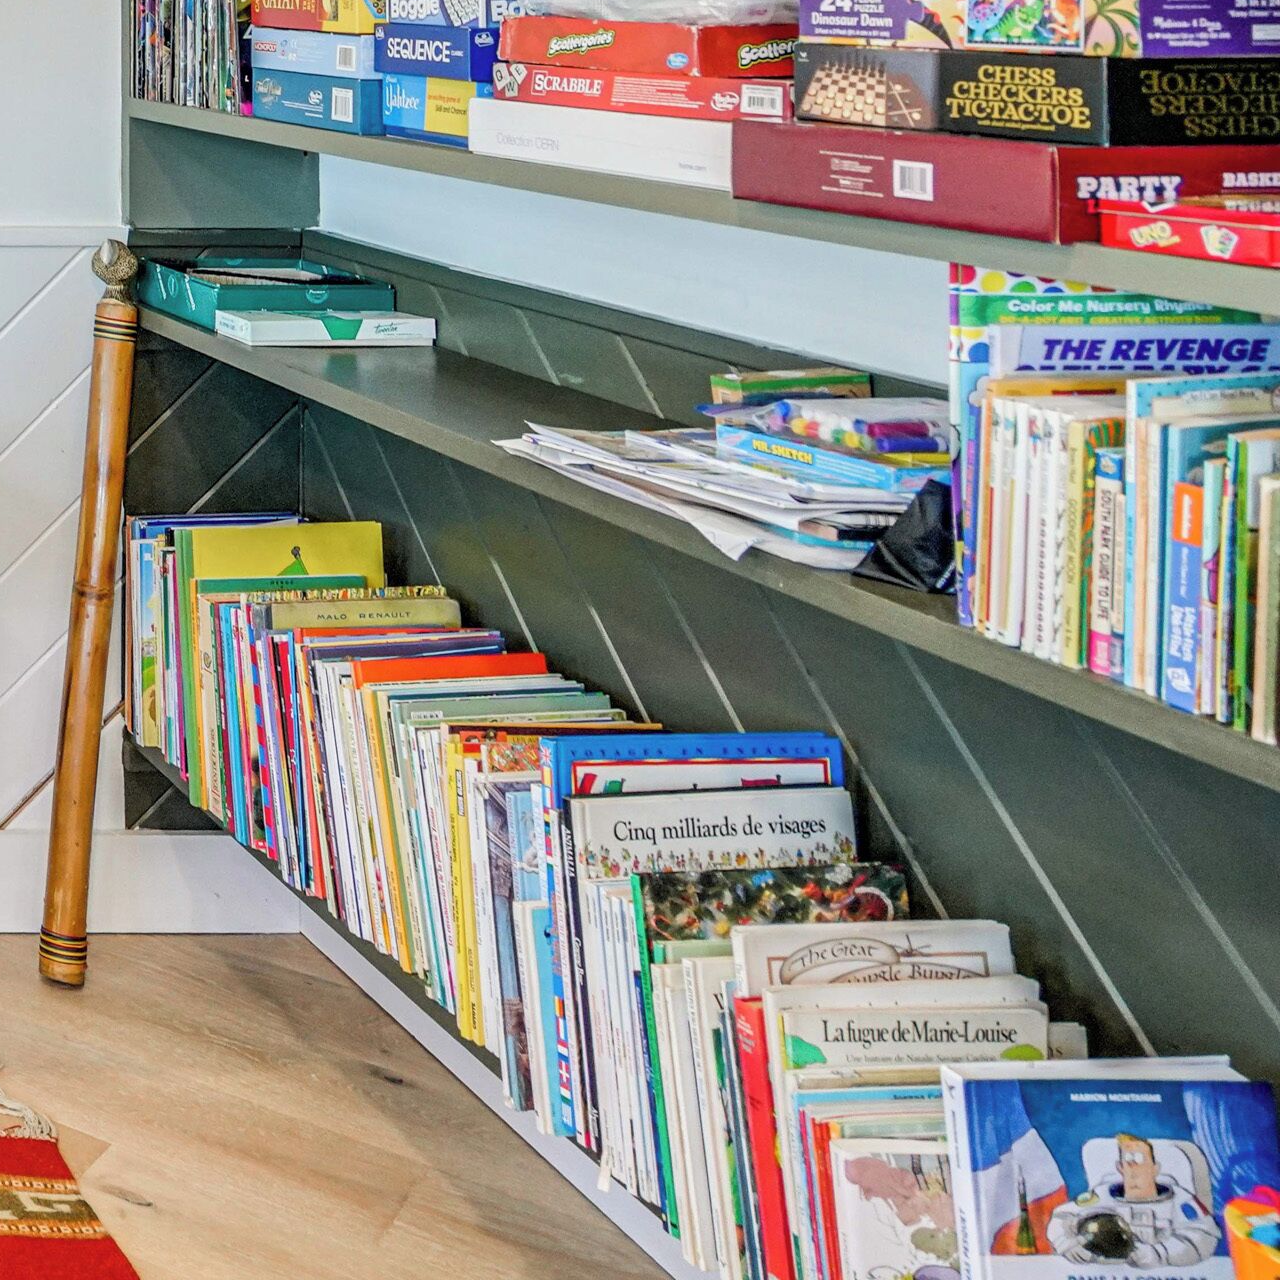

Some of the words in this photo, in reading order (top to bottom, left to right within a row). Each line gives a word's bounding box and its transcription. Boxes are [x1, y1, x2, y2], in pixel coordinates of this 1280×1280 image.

[811, 11, 858, 26] Dinosaur
[860, 13, 893, 28] Dawn
[854, 4, 885, 14] PUZZLE
[387, 37, 451, 62] SEQUENCE
[548, 32, 615, 57] Scattergories
[495, 69, 504, 82] Q
[535, 74, 603, 95] SCRABBLE
[977, 64, 1056, 87] CHESS
[384, 81, 420, 116] Yahtzee
[952, 81, 1084, 107] CHECKERS
[496, 132, 533, 150] Collection
[535, 135, 560, 151] CERN
[1077, 175, 1182, 202] PARTY
[1130, 221, 1172, 246] UNO
[1008, 299, 1053, 313] Color
[1058, 299, 1083, 313] Me
[1086, 299, 1151, 315] Nursery
[1043, 338, 1106, 361] THE
[1109, 338, 1271, 362] REVENGE
[1099, 489, 1112, 521] SOUTH
[1068, 498, 1078, 552] GOODNIGHT
[1067, 555, 1077, 584] MOON
[1098, 552, 1110, 582] GUIDE
[1098, 584, 1109, 597] TO
[317, 613, 347, 621] MALO
[358, 611, 411, 619] RENAULT
[1097, 598, 1109, 620] LIFE
[570, 748, 664, 758] VOYAGES
[613, 819, 657, 845] Cinq
[662, 817, 738, 840] milliards
[742, 815, 763, 836] de
[769, 814, 827, 842] visages
[563, 826, 576, 879] ANIMALIA
[799, 947, 828, 968] The
[830, 942, 879, 959] Great
[822, 1020, 845, 1043] La
[847, 1019, 890, 1049] fugue
[892, 1020, 910, 1043] de
[911, 1020, 1018, 1044] Marie-Louise
